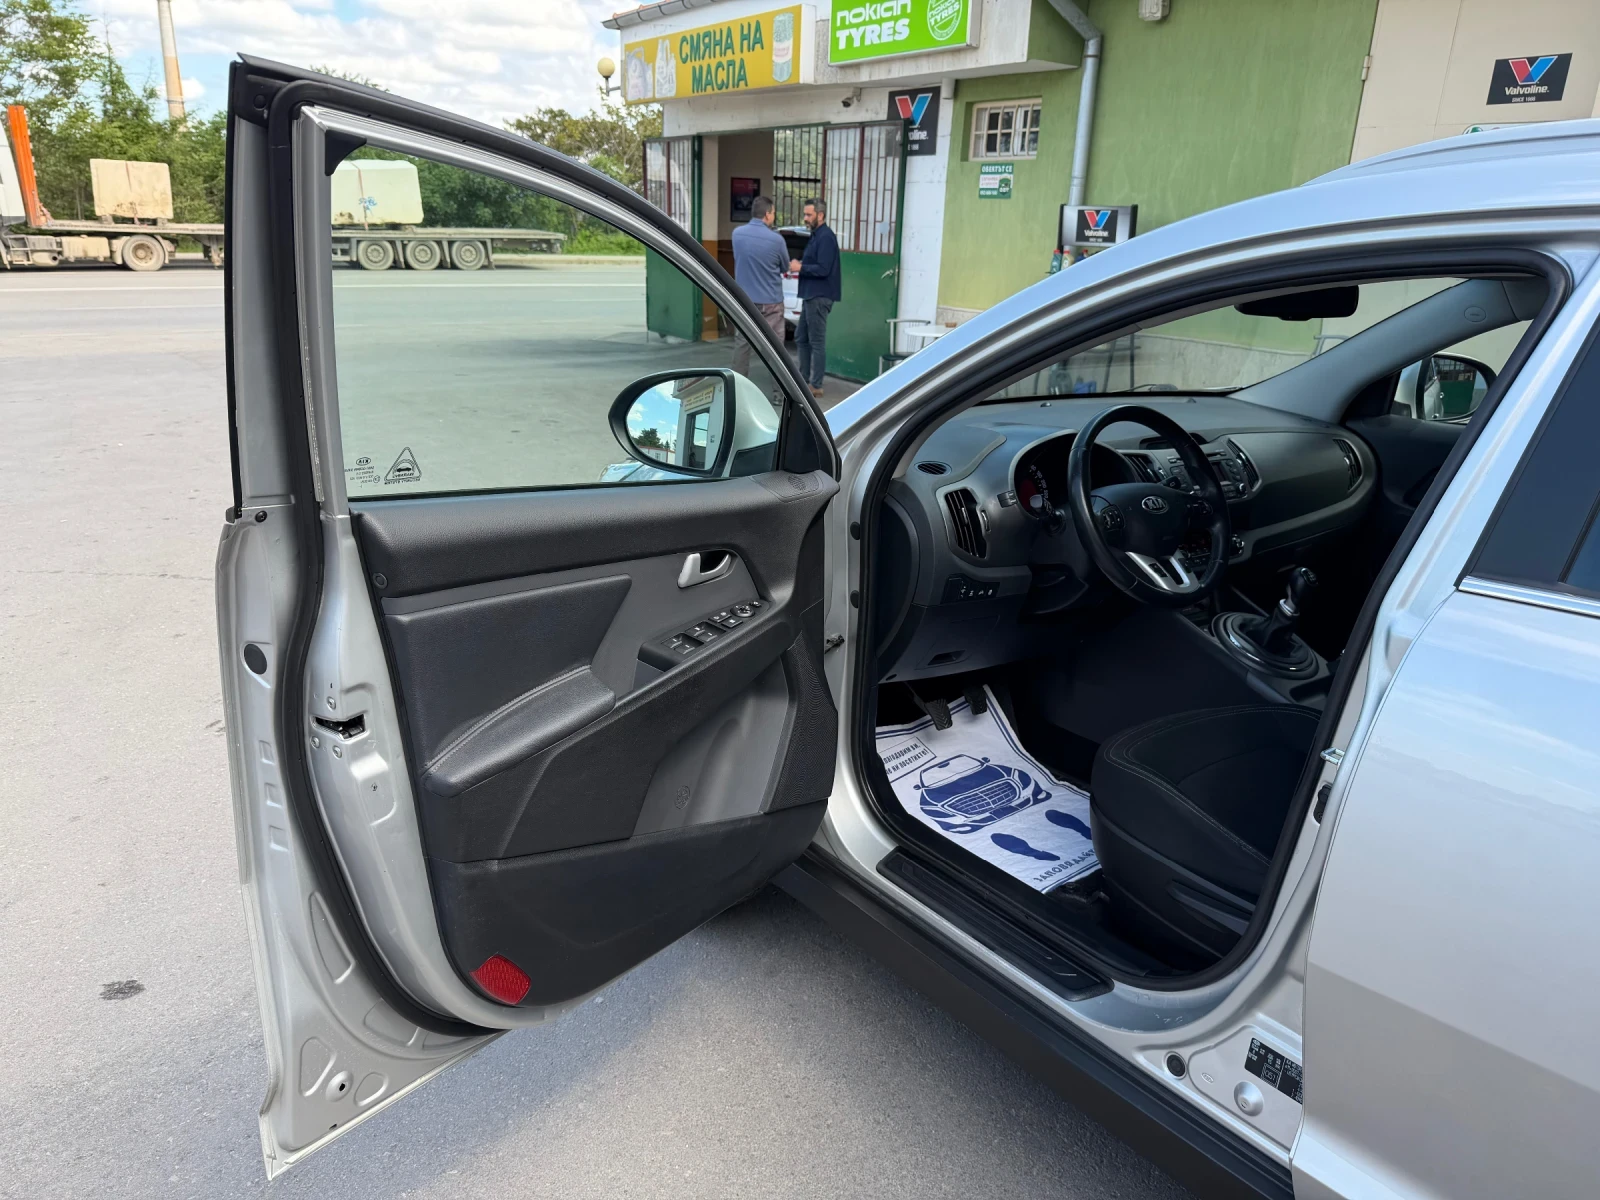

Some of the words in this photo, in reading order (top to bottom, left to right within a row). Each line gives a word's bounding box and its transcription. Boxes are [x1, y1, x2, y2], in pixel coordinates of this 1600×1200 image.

[930, 1, 960, 26] TYRES
[679, 25, 735, 64] СМЯНА
[740, 19, 764, 54] НА
[836, 18, 910, 50] TYRES
[691, 57, 748, 94] МАСЛА
[1145, 496, 1166, 510] KIA
[882, 746, 912, 764] лагодарим
[1033, 849, 1095, 882] ЗАПОВЯДАЙТ
